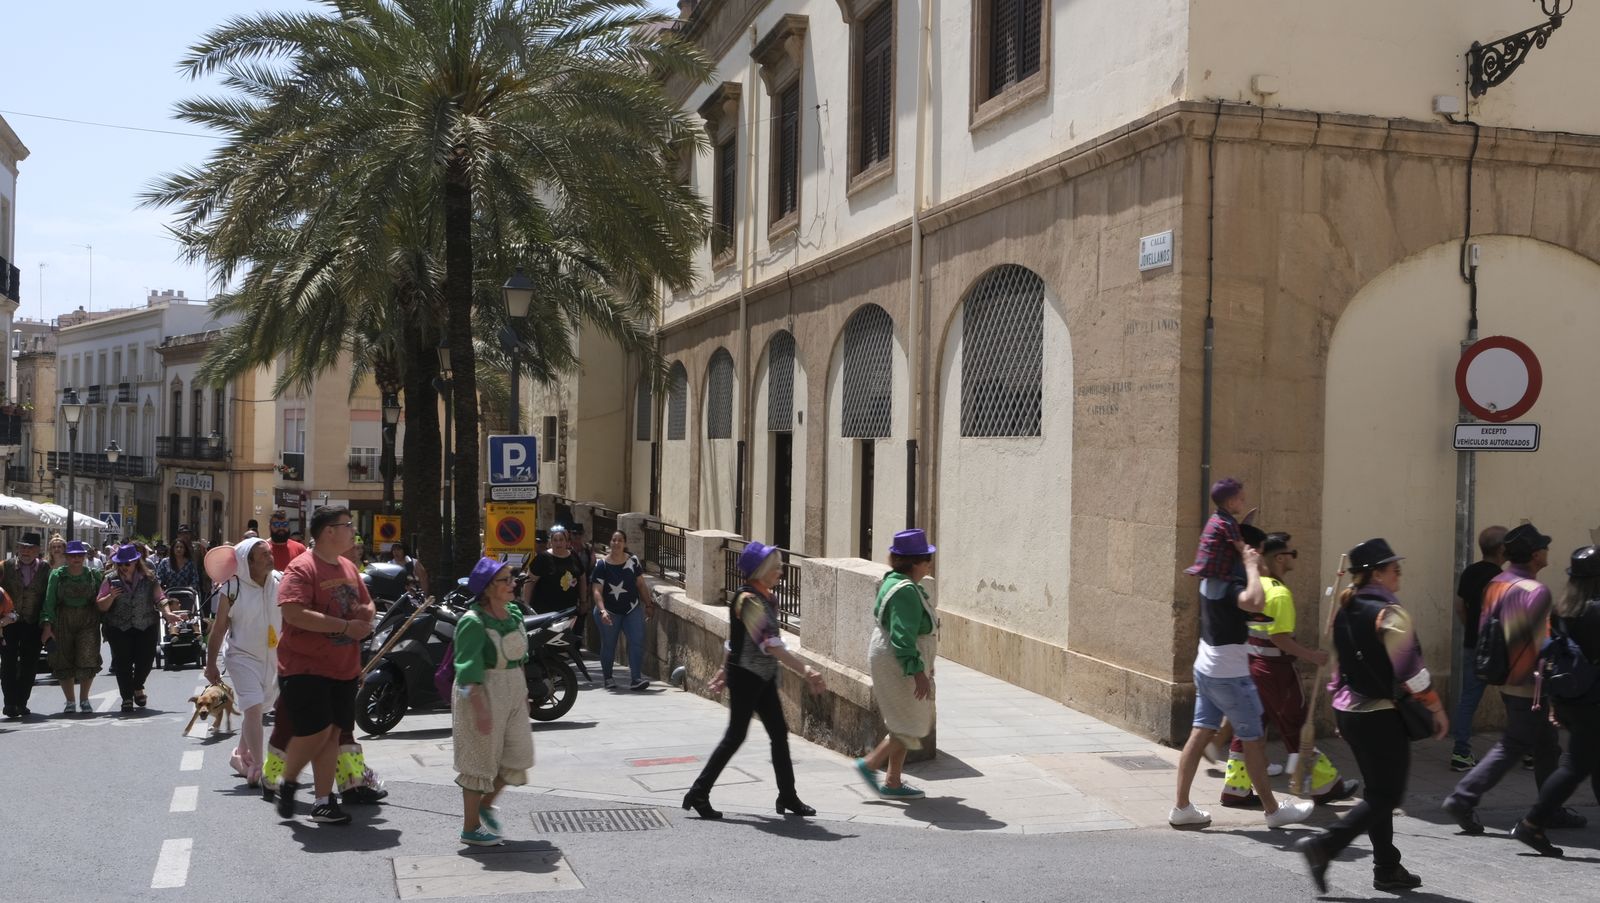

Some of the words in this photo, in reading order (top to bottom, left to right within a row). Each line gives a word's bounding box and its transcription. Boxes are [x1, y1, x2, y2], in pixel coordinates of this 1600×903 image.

[1150, 235, 1167, 247] CALLE
[1140, 248, 1170, 267] JOVELLANOS
[1122, 319, 1179, 337] JOVLLANOS
[1481, 427, 1507, 435] EXCEPTO
